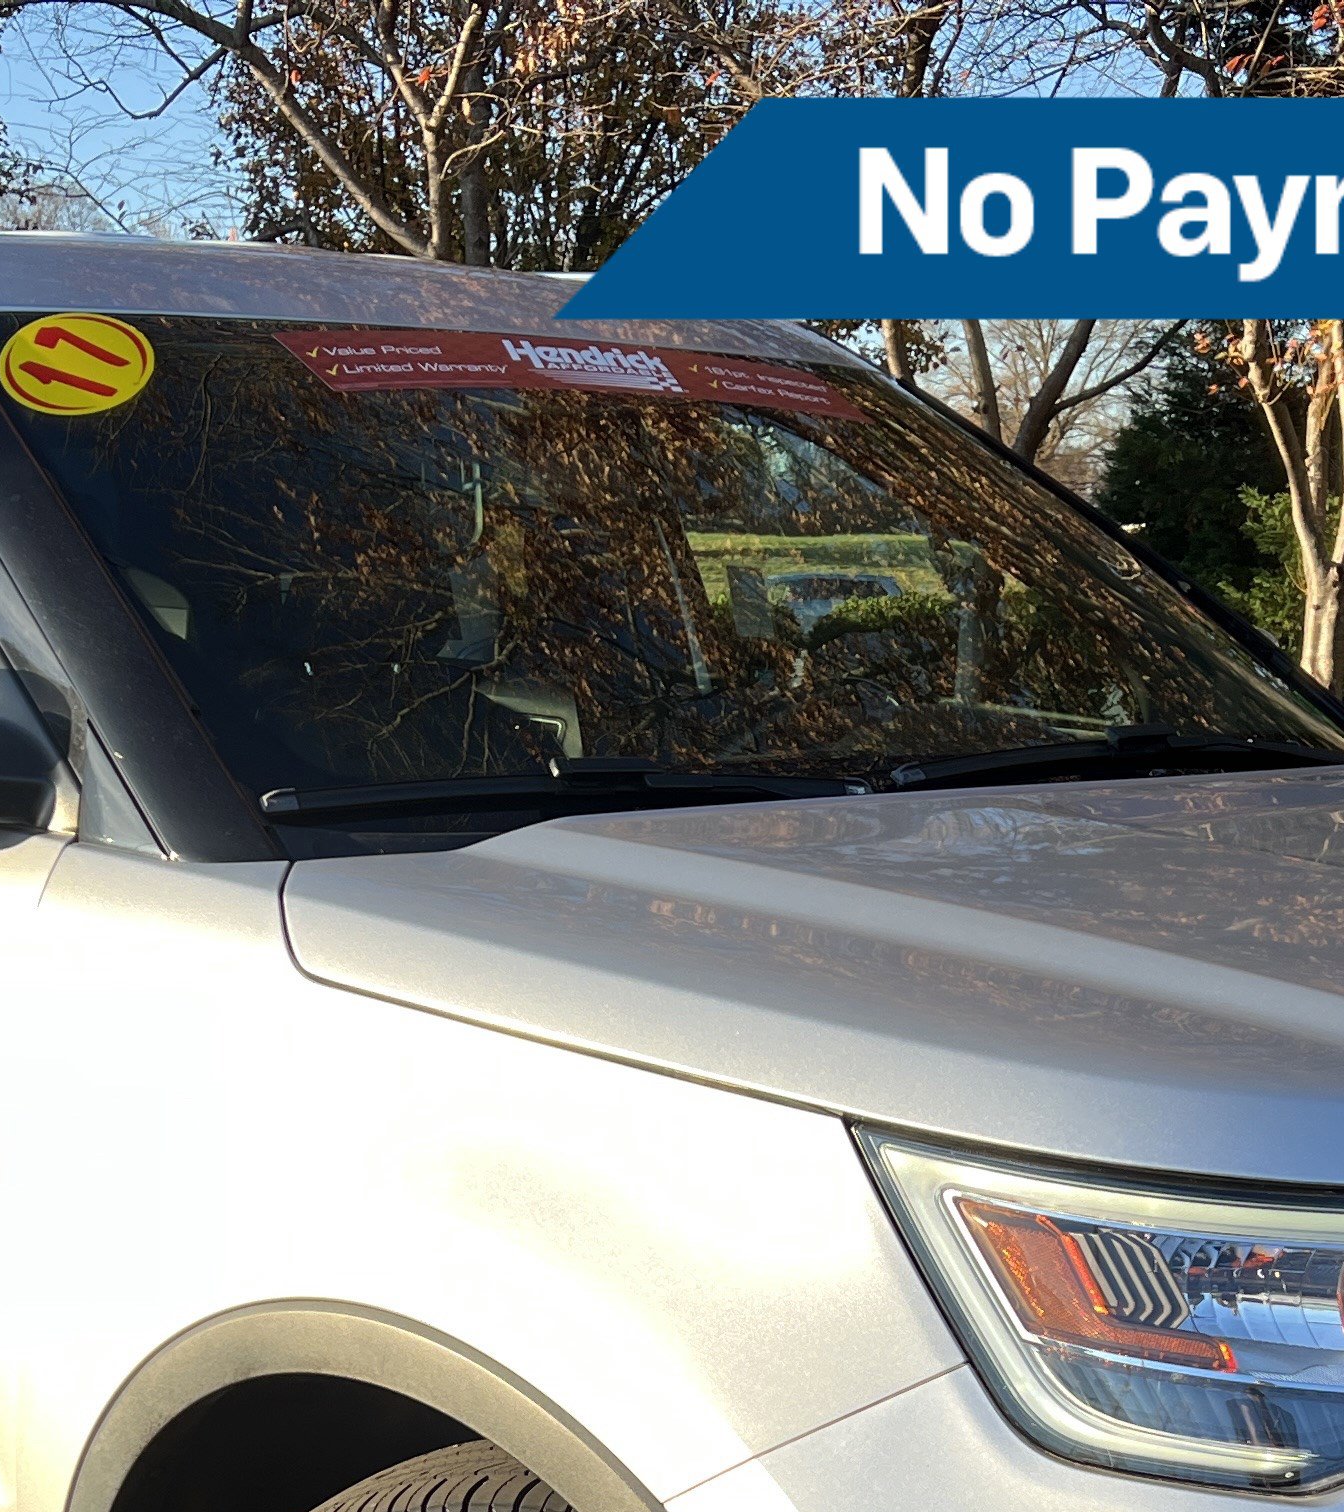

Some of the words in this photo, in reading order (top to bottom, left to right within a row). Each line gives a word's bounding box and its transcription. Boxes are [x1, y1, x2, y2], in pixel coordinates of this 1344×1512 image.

[18, 326, 130, 397] 17
[322, 345, 376, 357] Value
[380, 344, 443, 355] Priced
[502, 339, 670, 372] Hendrick
[343, 363, 414, 374] Limited
[417, 362, 508, 374] Warranty
